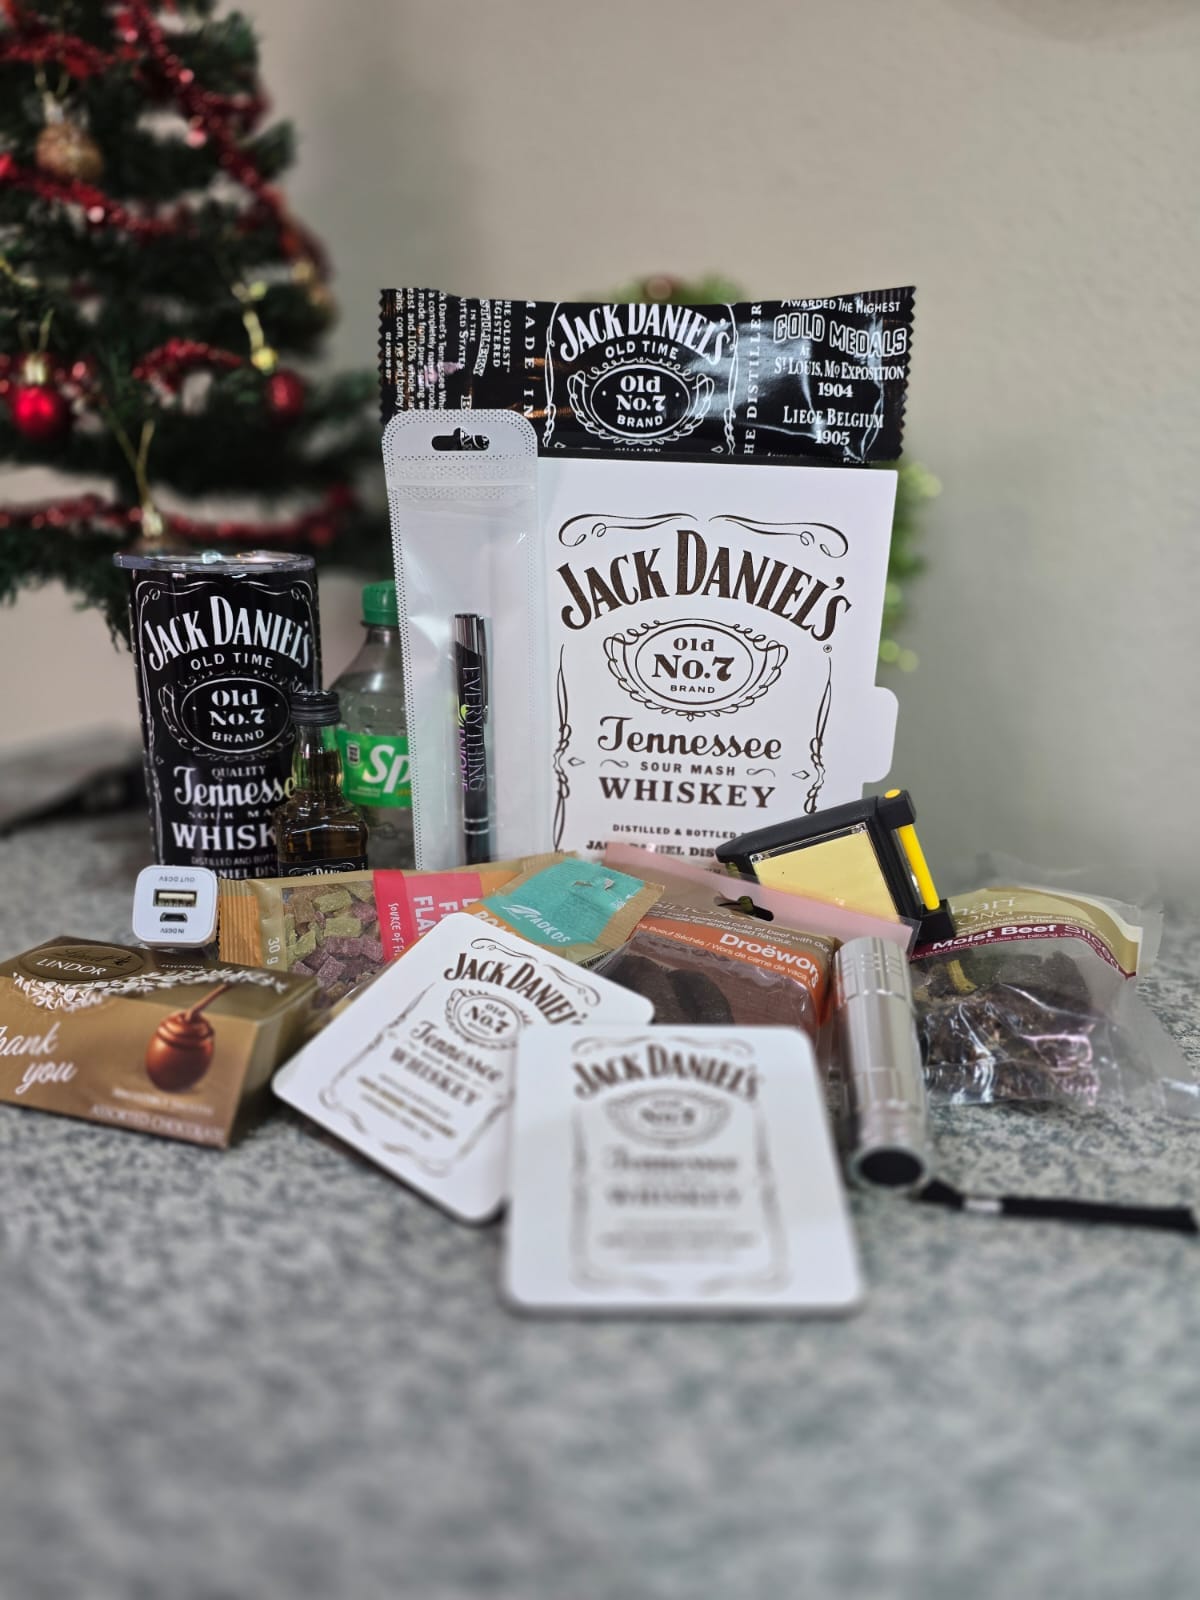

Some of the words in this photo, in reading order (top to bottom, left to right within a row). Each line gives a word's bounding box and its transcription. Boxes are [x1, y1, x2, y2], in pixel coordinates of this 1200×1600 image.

[407, 288, 416, 309] east
[781, 300, 836, 310] AWARDED
[838, 298, 853, 312] THE
[856, 300, 900, 314] HIGHEST
[459, 298, 467, 328] NITED
[473, 300, 491, 377] STILLERY
[493, 301, 503, 368] EGISTERED
[557, 304, 624, 362] JACK
[627, 303, 731, 365] DANIEL'S
[774, 312, 825, 344] GOLD
[830, 320, 907, 358] MEDALS
[605, 341, 636, 358] OLD
[641, 341, 679, 360] TIME
[747, 304, 762, 418] DISTILLER
[841, 361, 906, 381] EXPOSITION
[620, 375, 661, 393] Old
[818, 382, 854, 398] 1904
[428, 384, 436, 410] produ
[616, 394, 666, 411] No.7
[617, 414, 664, 428] BRAND
[783, 406, 824, 425] LIEGE
[827, 408, 884, 428] BELGIUM
[744, 428, 756, 454] HE
[815, 430, 850, 446] 1905
[556, 547, 670, 630] JACK
[675, 530, 852, 642] DANIEL'S
[144, 610, 209, 671] JACK
[209, 596, 312, 668] DANIEL'S
[673, 637, 714, 652] Old
[190, 653, 225, 670] OLD
[232, 652, 274, 668] TIME
[651, 654, 735, 682] No.7
[211, 689, 258, 706] Old
[670, 684, 716, 694] BRAND
[208, 708, 264, 726] No.7
[212, 730, 264, 744] BRAND
[462, 666, 486, 792] EVERYTHING
[598, 716, 782, 760] Tennessee
[212, 766, 267, 780] QUALITY
[362, 744, 408, 793] Sp
[640, 761, 682, 774] SOUR
[690, 764, 736, 776] MASH
[174, 765, 297, 806] Tennesse
[598, 776, 776, 808] WHISKEY
[171, 822, 277, 850] WHISK
[612, 824, 670, 836] DISTILLED
[674, 828, 682, 836] &
[686, 828, 736, 840] BOTTLED
[586, 840, 608, 850] JA
[689, 847, 716, 858] DIS
[388, 903, 402, 932] SOURCE
[413, 896, 433, 938] FLA
[268, 937, 280, 954] 30
[392, 934, 404, 945] OF
[792, 935, 813, 944] with
[932, 930, 996, 950] Moist
[1001, 924, 1056, 935] Beef
[36, 958, 108, 976] LINDOR
[266, 956, 278, 966] g
[444, 952, 512, 985] JACK
[712, 943, 734, 955] Wors
[734, 950, 747, 959] de
[747, 955, 772, 967] carne
[773, 964, 786, 972] de
[15, 1060, 78, 1095] you
[572, 1054, 646, 1100] JACK
